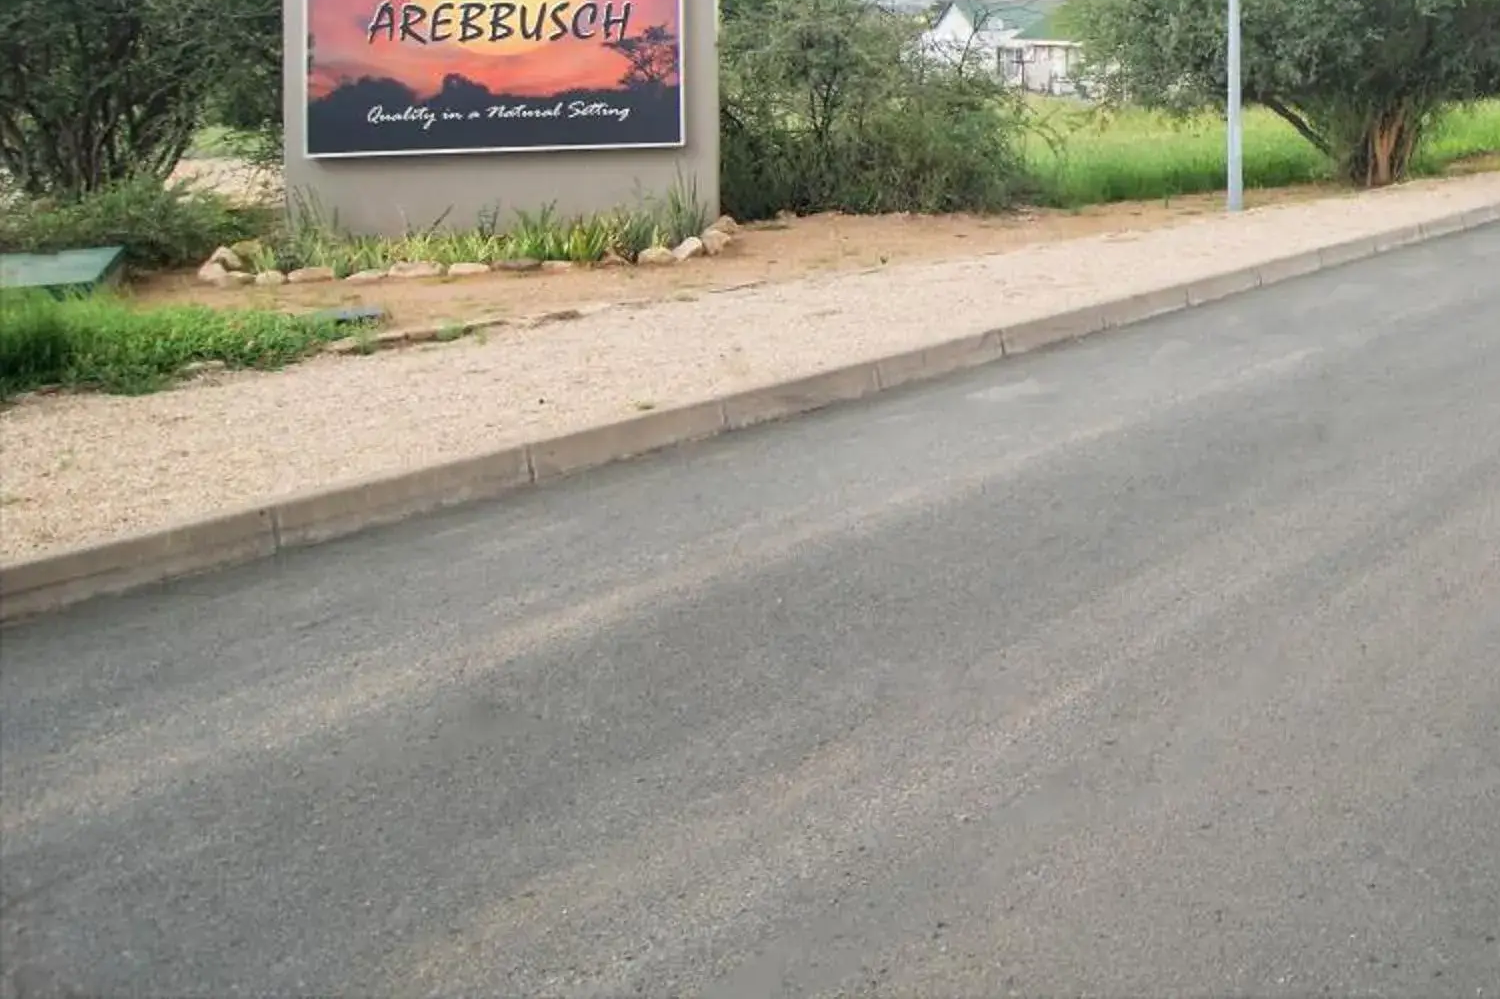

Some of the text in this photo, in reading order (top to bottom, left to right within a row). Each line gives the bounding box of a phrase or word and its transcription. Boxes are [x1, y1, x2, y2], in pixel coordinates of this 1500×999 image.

[367, 1, 632, 44] AREBBUSCH
[367, 100, 631, 130] Quality in a Natural Setting
